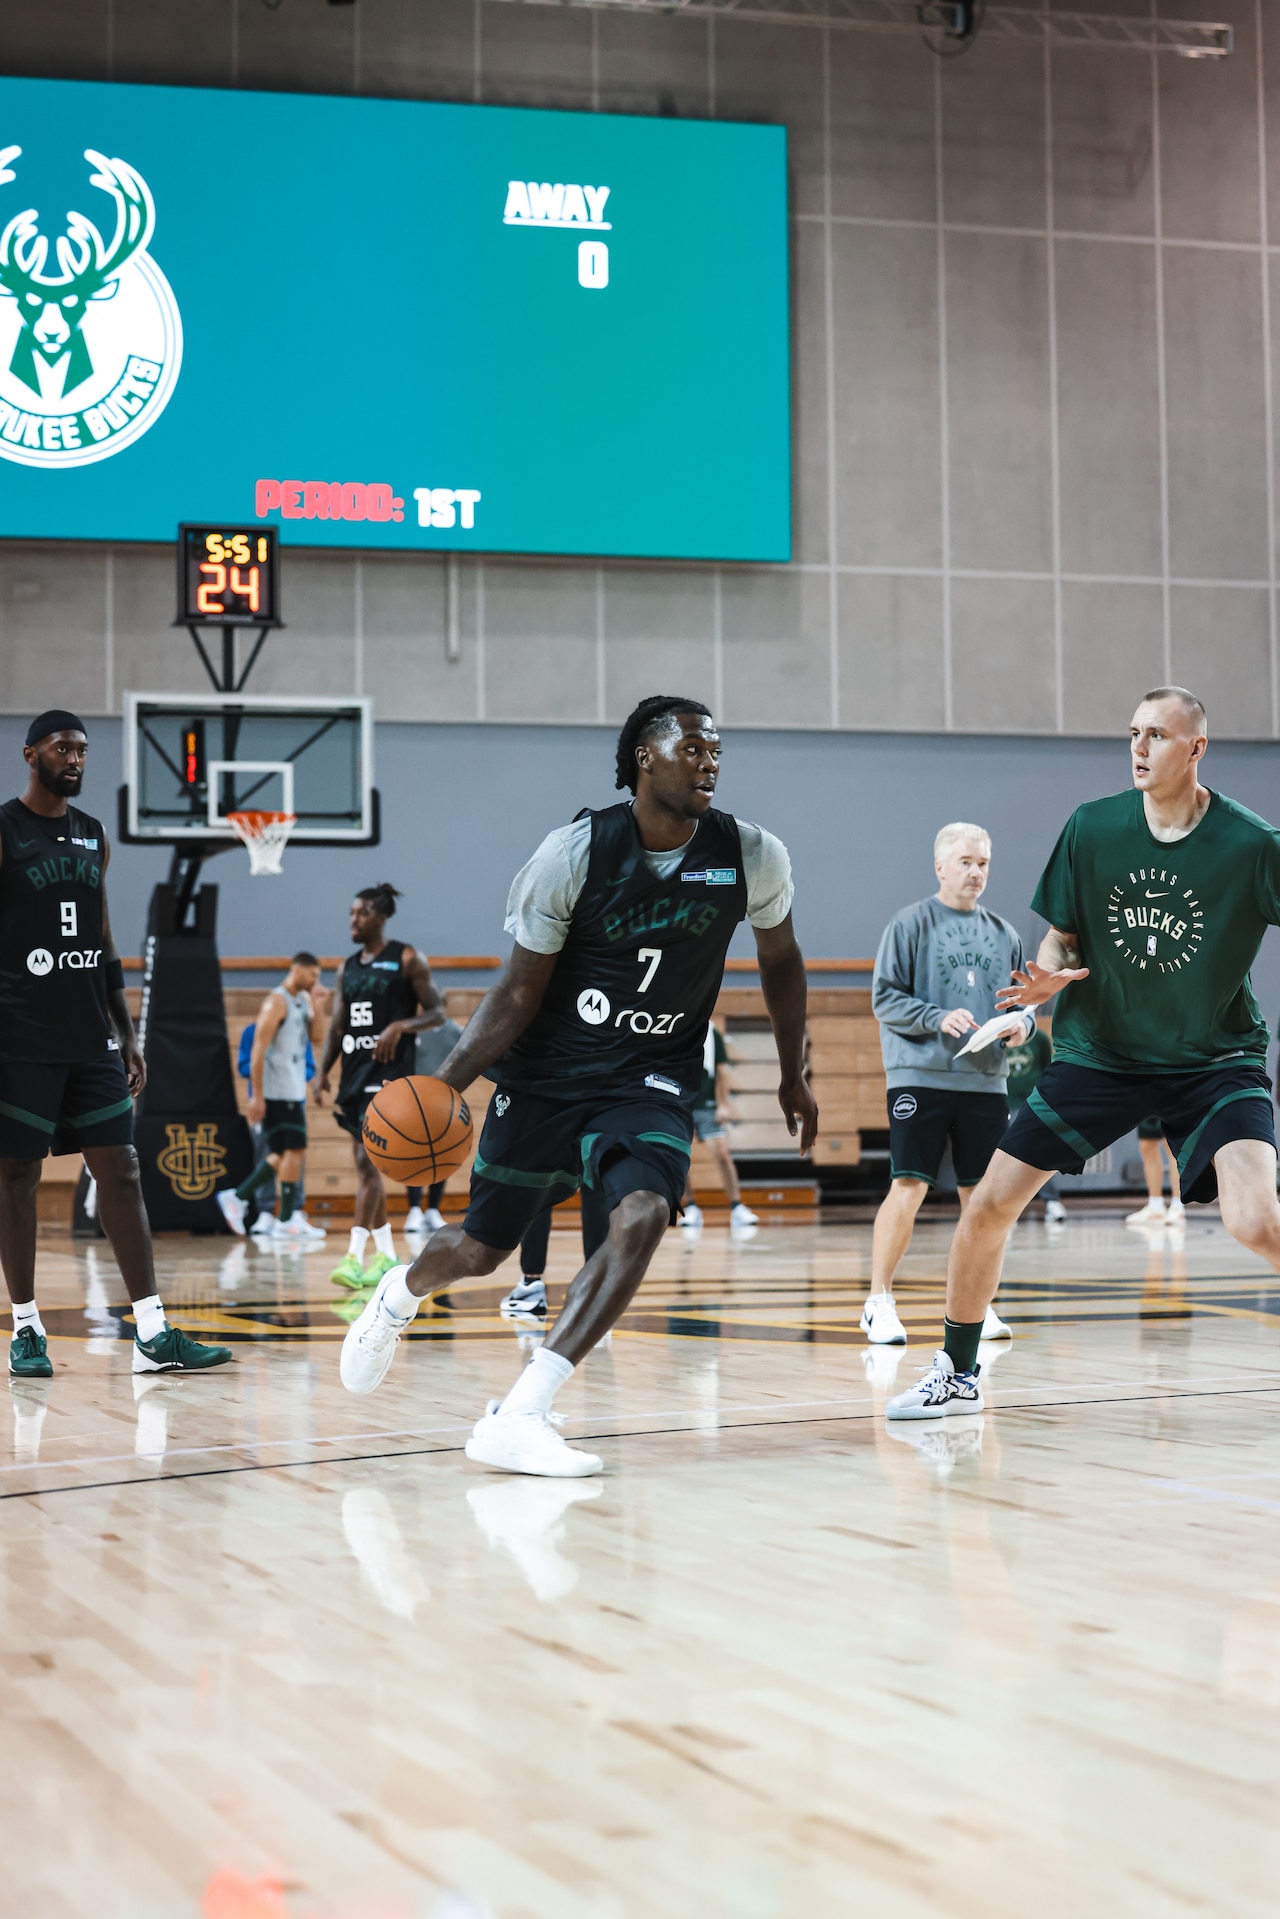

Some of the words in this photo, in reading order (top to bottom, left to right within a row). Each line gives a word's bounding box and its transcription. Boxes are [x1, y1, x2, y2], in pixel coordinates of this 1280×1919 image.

[504, 181, 611, 222] AWAY
[578, 240, 609, 289] 0
[82, 356, 162, 441] BUCKS
[255, 479, 405, 522] PERIOD:
[413, 487, 482, 529] 1ST
[205, 533, 268, 565] 5:51
[197, 563, 259, 614] 24
[26, 856, 100, 891] BUCKS
[60, 902, 78, 936] 9
[602, 897, 720, 942] BUCKS
[1107, 885, 1147, 970] MILWAUKEE
[1129, 868, 1177, 886] BUCKS
[1159, 889, 1204, 974] BASKETBALL
[1123, 906, 1188, 940] BUCKS
[58, 950, 102, 970] razr
[636, 947, 662, 993] 7
[948, 952, 992, 971] BUCKS
[350, 1001, 374, 1028] 55
[614, 1010, 685, 1035] razr
